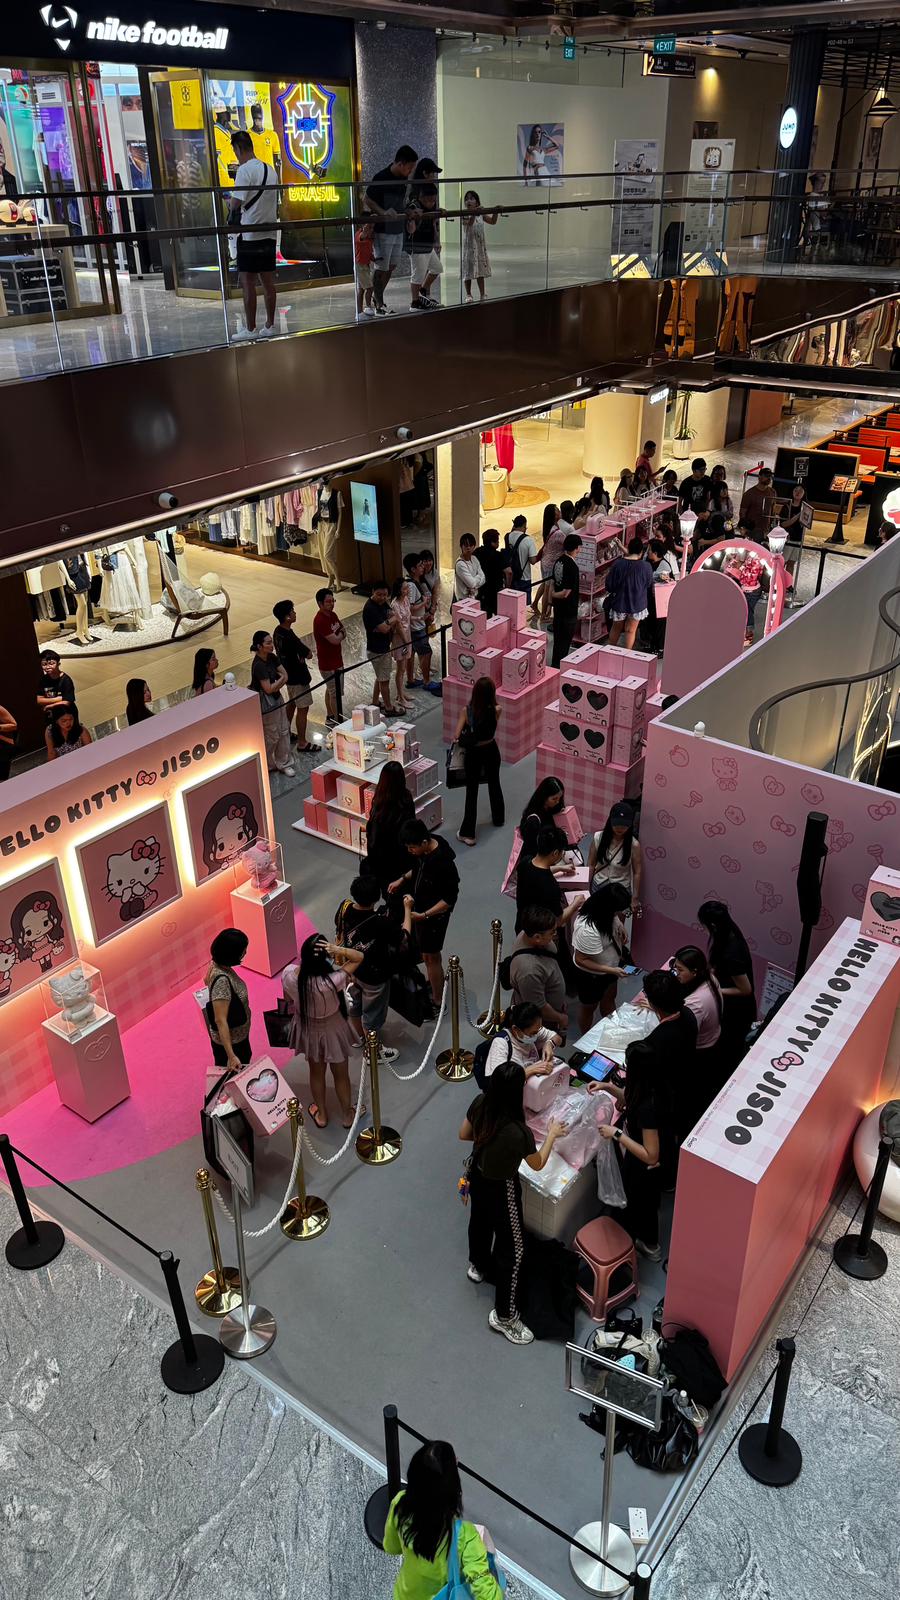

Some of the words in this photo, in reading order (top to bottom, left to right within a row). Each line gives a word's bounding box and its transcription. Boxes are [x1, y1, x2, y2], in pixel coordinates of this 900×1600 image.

[87, 17, 141, 43] nike
[141, 20, 229, 50] football
[660, 41, 674, 51] EXIT
[288, 185, 340, 203] BRASIL
[0, 814, 61, 857] ELLO
[66, 777, 132, 824] KITTY
[160, 737, 220, 778] JISOO
[827, 937, 879, 992] HELLO
[787, 992, 843, 1053] KITTY
[724, 1070, 787, 1146] JISOO
